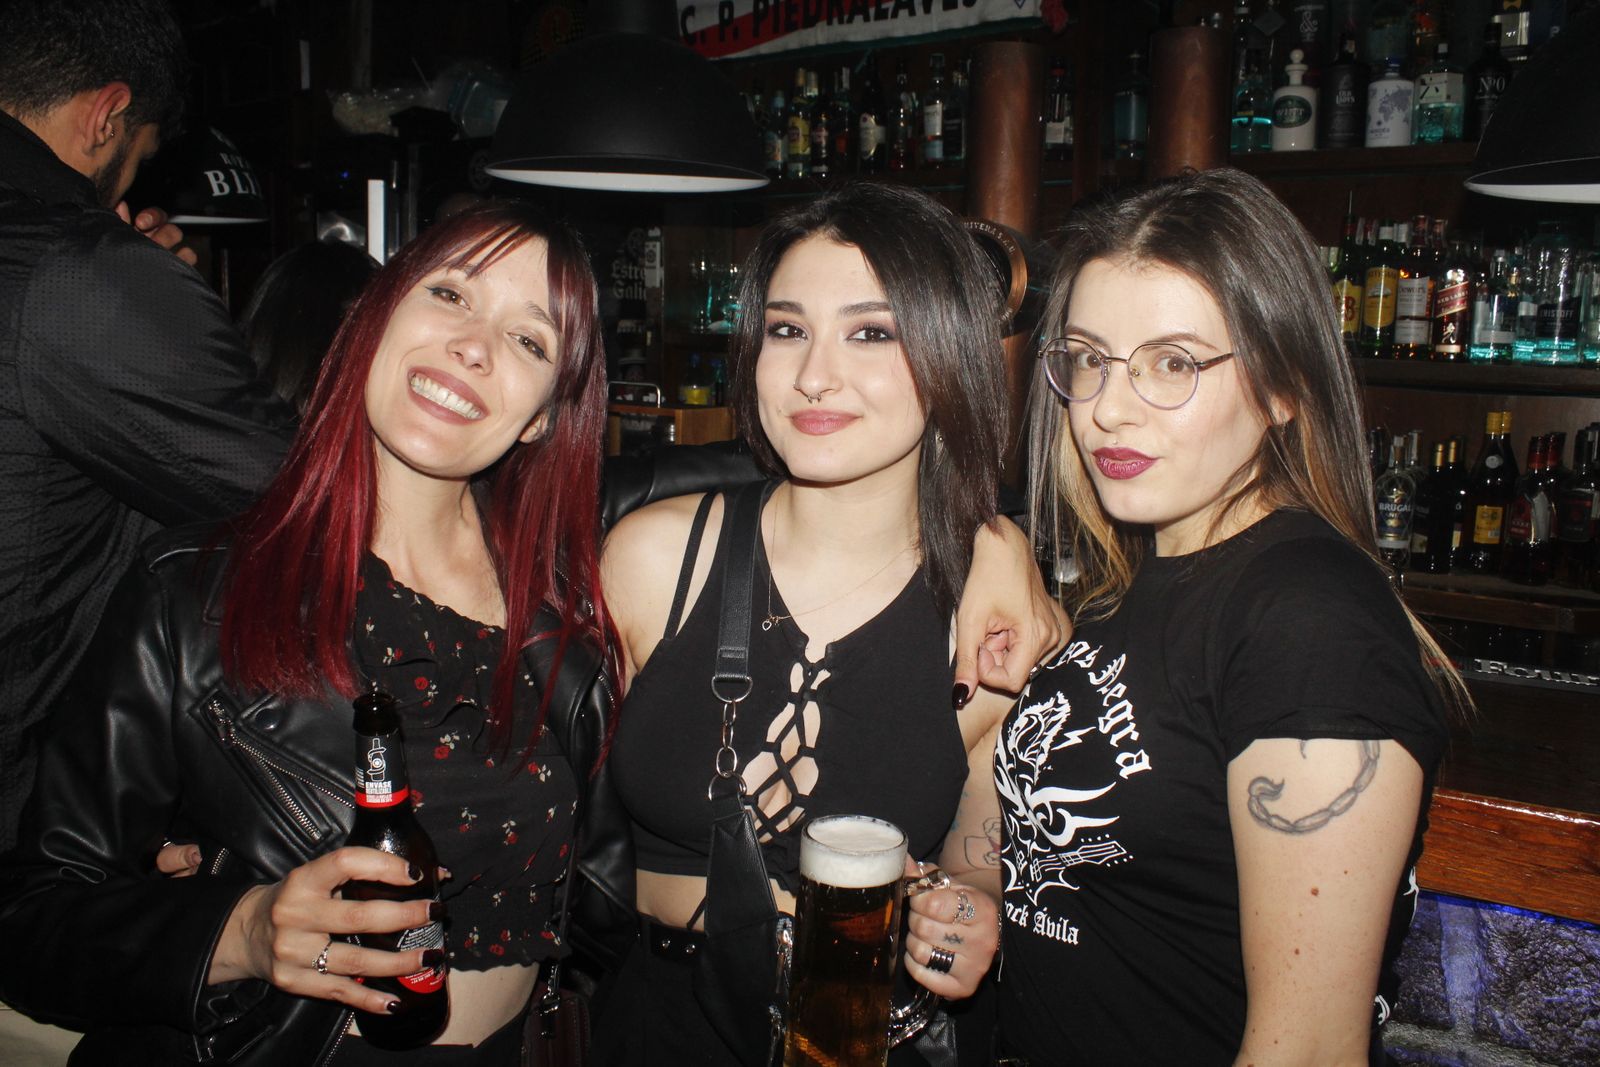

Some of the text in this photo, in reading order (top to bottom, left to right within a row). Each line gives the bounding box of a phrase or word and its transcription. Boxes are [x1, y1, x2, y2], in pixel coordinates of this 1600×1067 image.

[681, 5, 706, 46] C.
[718, 1, 740, 43] P.
[1004, 900, 1079, 945] ock Ávila
